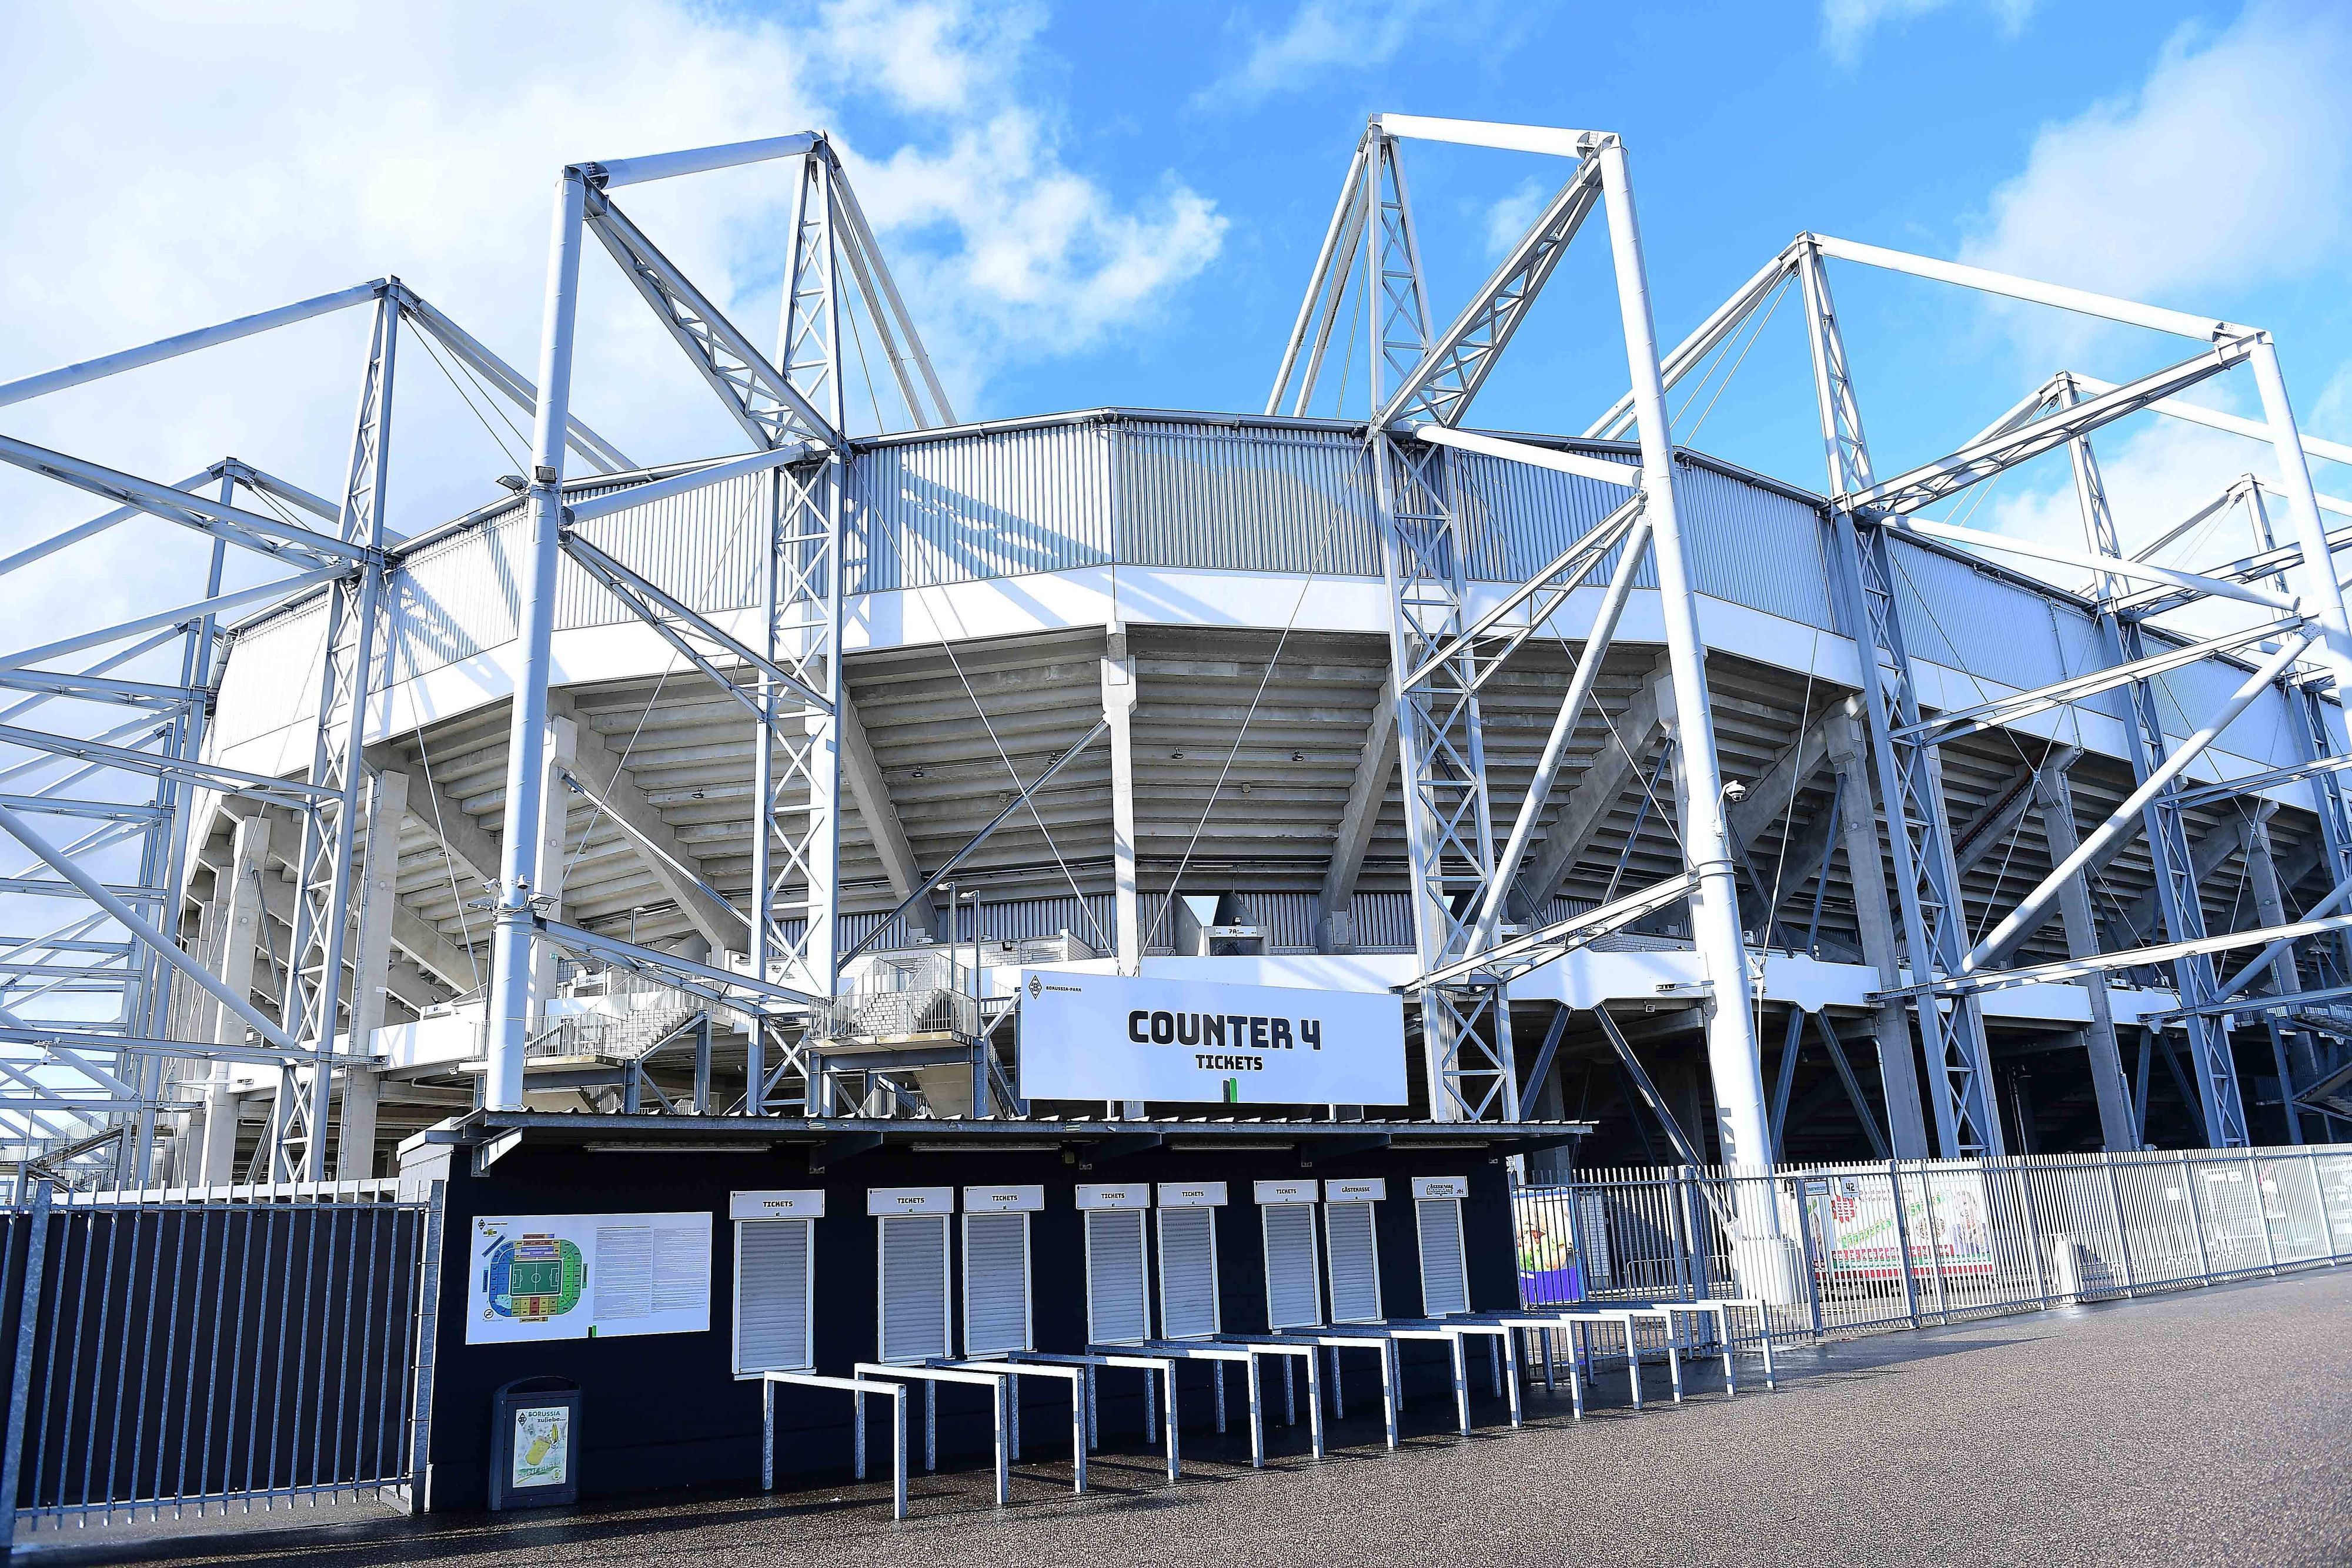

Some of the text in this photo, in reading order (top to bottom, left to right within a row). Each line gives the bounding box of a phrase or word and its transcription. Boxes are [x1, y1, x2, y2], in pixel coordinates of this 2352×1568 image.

[1128, 1010, 1321, 1050] COUNTER 4
[1195, 1054, 1263, 1071] TICKETS
[1846, 1182, 1855, 1192] 42
